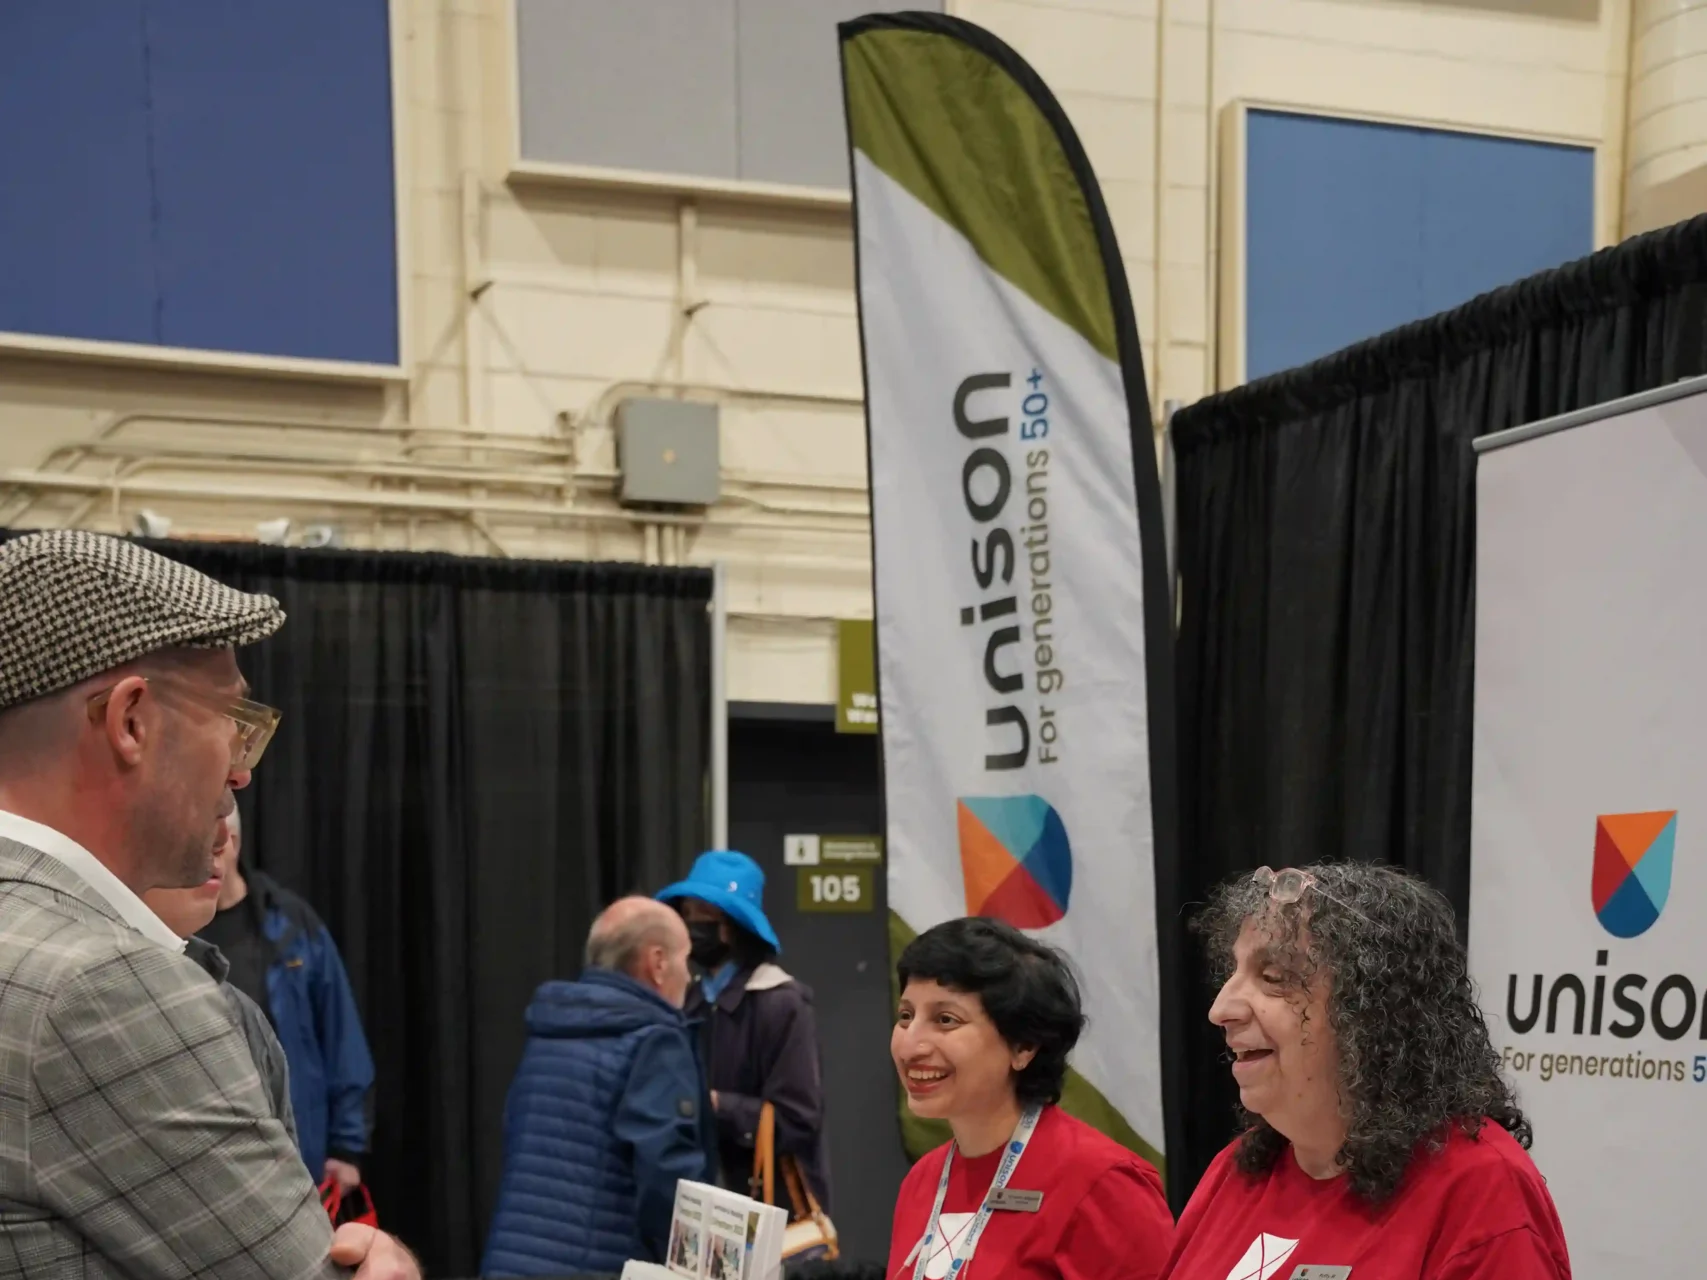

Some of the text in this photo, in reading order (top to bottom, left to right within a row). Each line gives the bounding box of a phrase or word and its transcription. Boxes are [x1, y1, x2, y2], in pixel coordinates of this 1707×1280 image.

[952, 371, 1031, 772] unison
[1020, 367, 1064, 765] For generations 50+
[810, 875, 861, 902] 105
[1507, 950, 1707, 1041] uniso
[1502, 1046, 1535, 1073] For
[1539, 1051, 1685, 1082] generations
